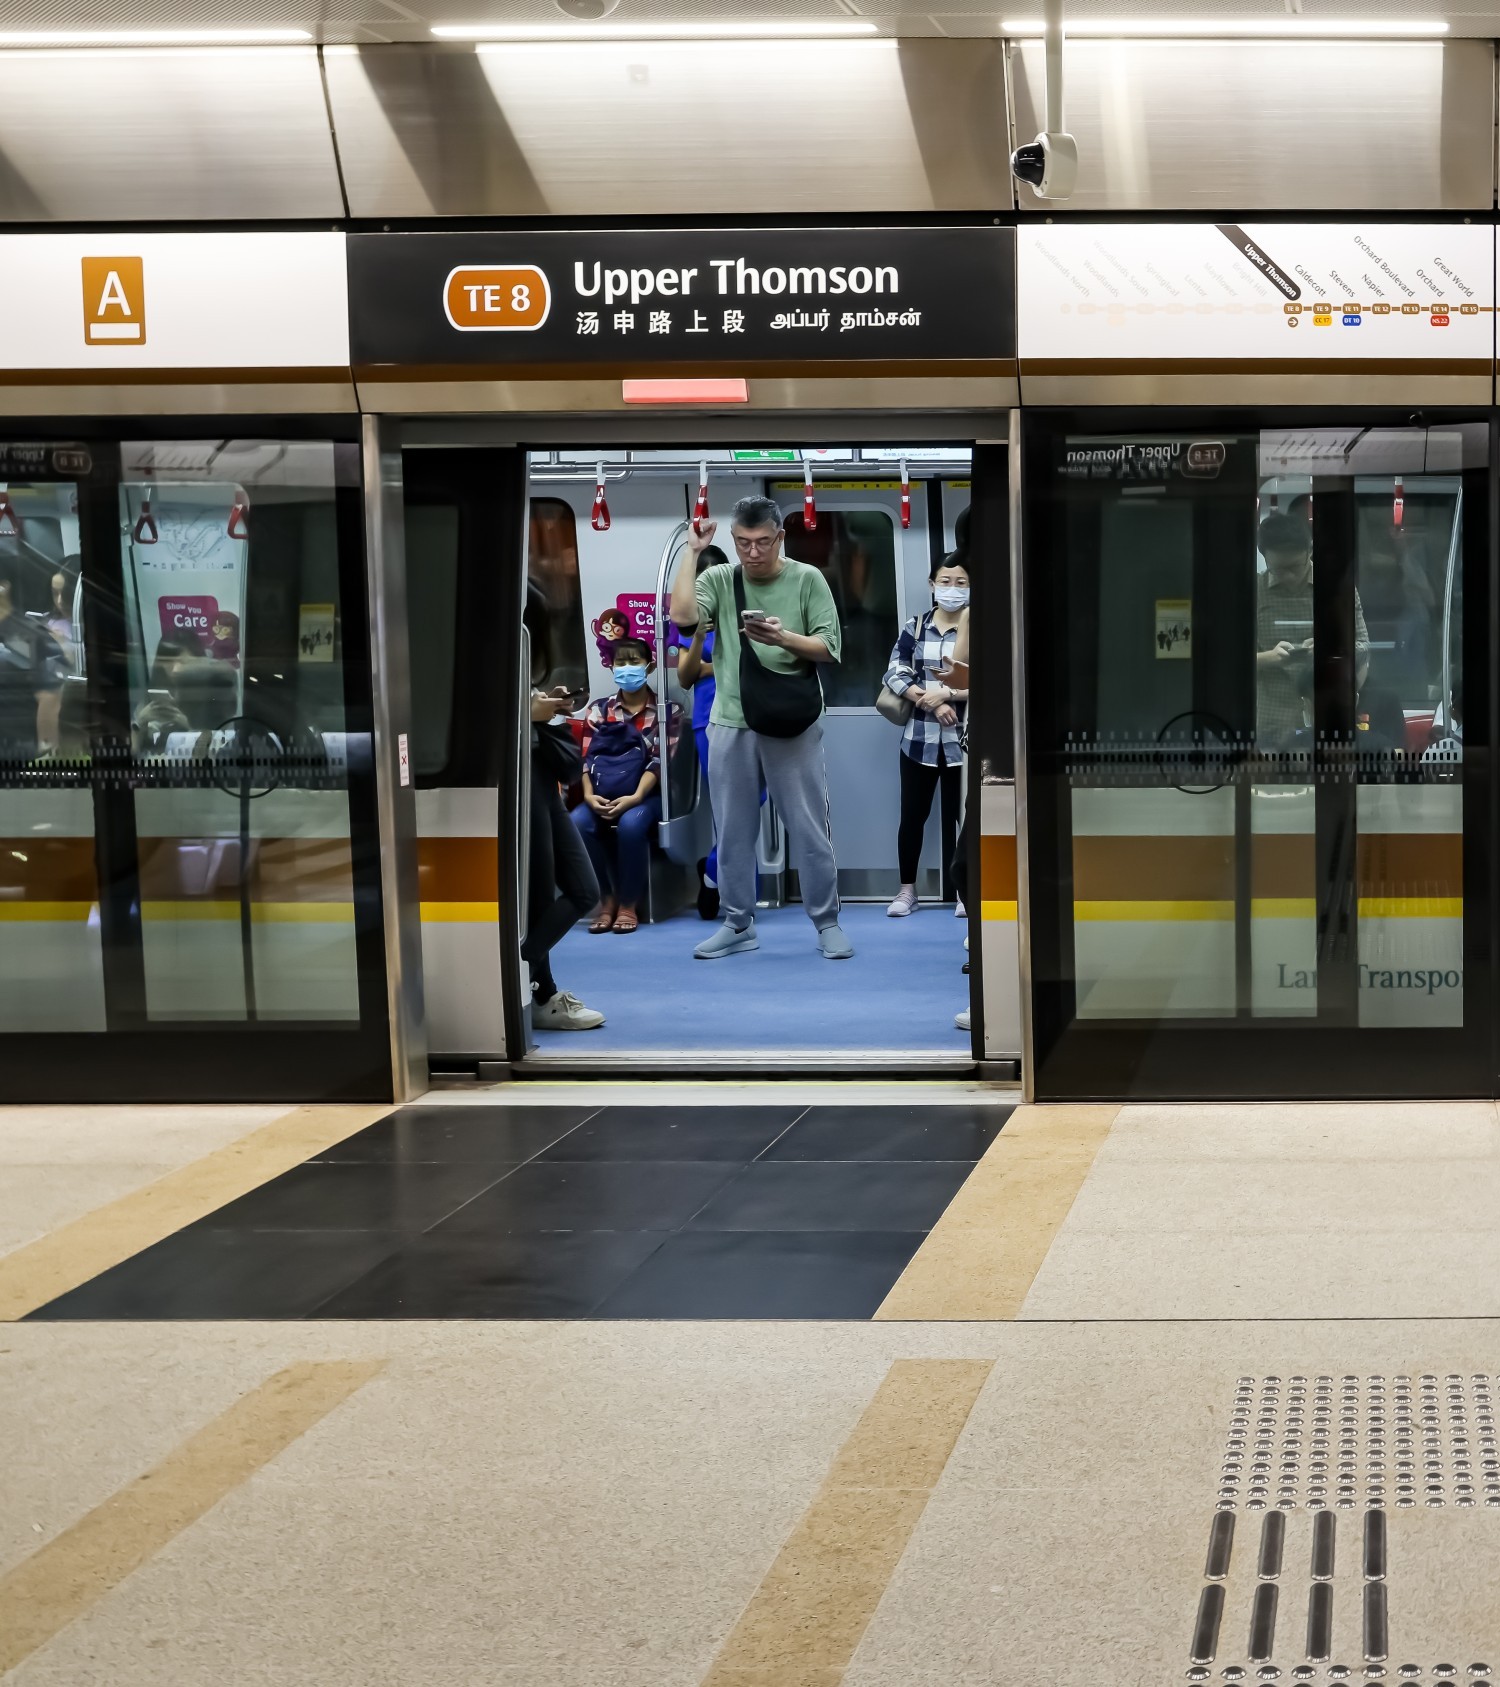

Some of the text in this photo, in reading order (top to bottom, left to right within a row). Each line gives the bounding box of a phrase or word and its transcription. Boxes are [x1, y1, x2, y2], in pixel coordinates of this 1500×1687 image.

[1244, 244, 1297, 298] Upper Thomson
[1354, 235, 1415, 297] Orchard Boulevard
[1433, 257, 1474, 298] Great World
[98, 270, 132, 316] A
[574, 258, 899, 304] Upper Thomson
[1294, 264, 1327, 297] Caldecott
[1329, 270, 1356, 298] Stevens
[1361, 274, 1385, 298] Napier
[1416, 269, 1445, 297] Orchard
[463, 284, 531, 312] TE 8
[575, 310, 746, 335] 汤申路上段
[770, 308, 922, 333] அப்பர் தாம்சன்
[166, 602, 186, 610] Show
[628, 600, 649, 608] Show
[174, 613, 208, 628] Care
[635, 611, 654, 626] Ca
[1358, 963, 1463, 995] Transpo
